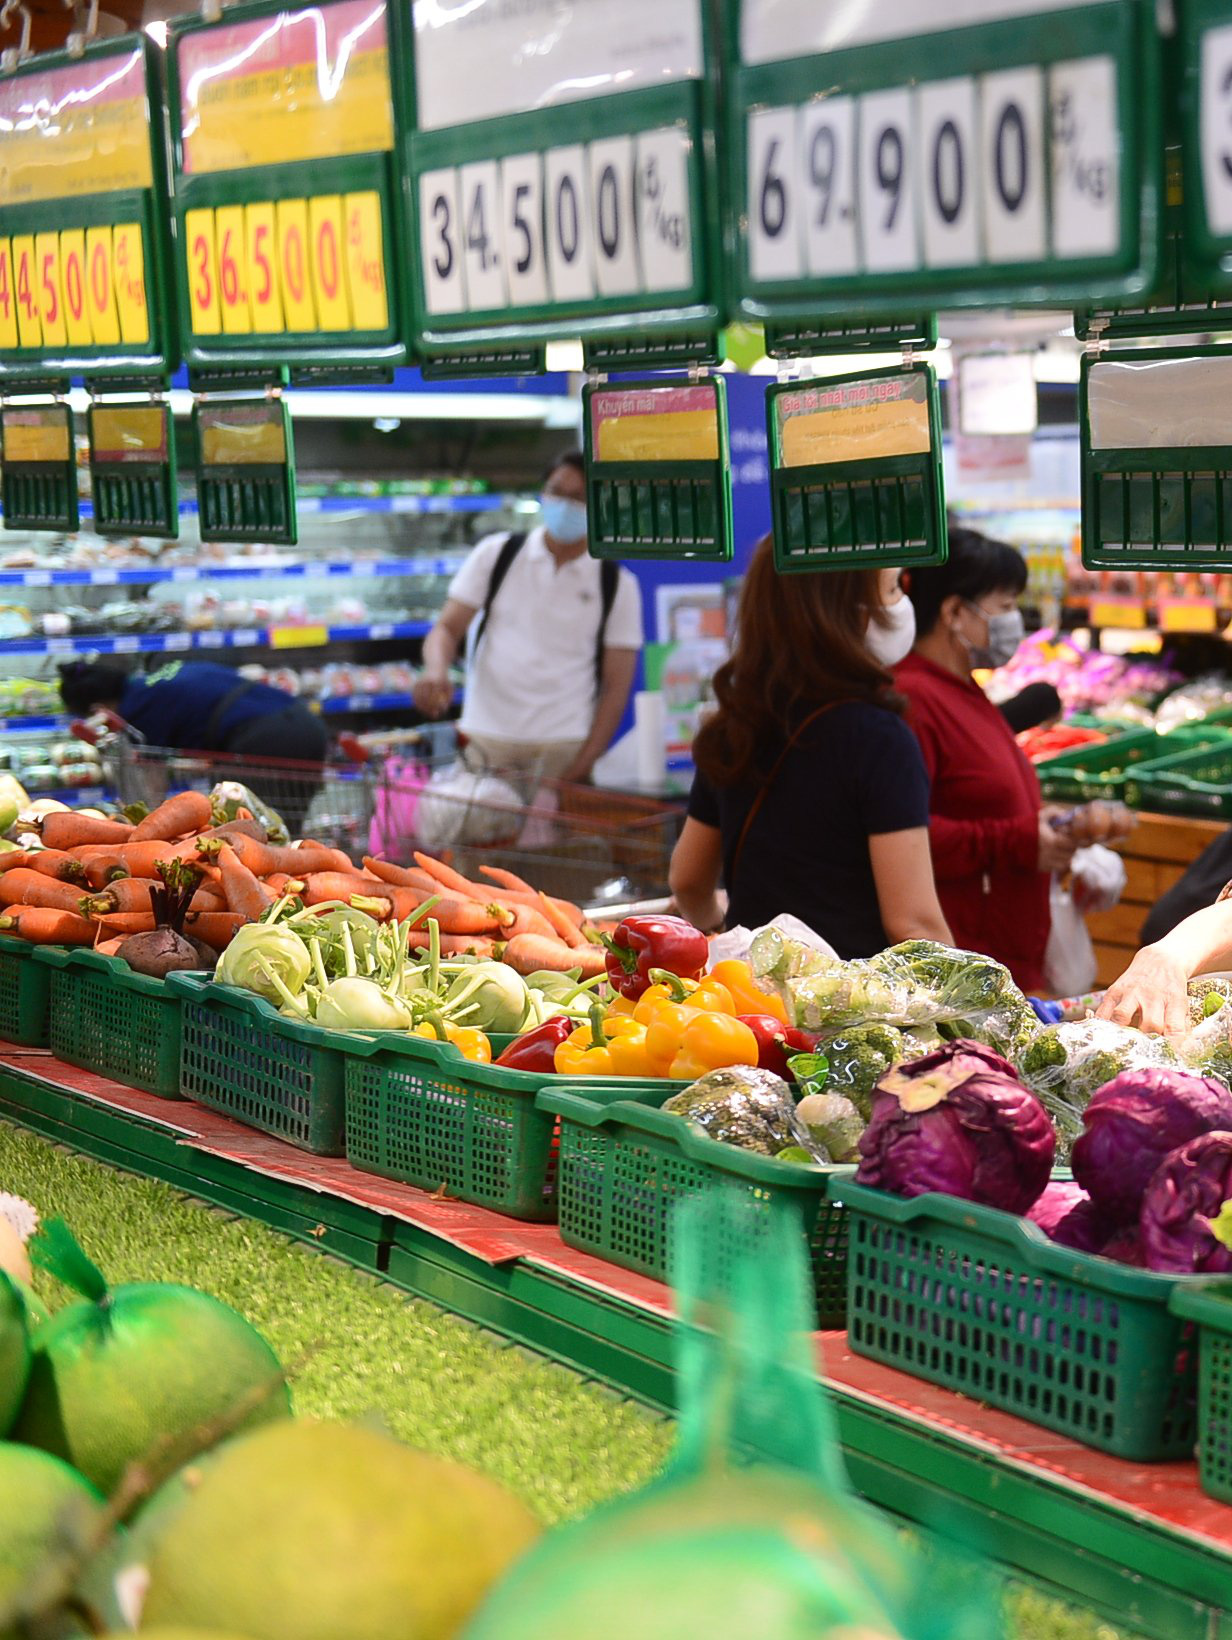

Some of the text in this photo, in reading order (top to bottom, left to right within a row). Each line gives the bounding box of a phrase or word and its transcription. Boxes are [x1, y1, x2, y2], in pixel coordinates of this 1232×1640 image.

[433, 164, 619, 279] 34.500
[761, 101, 1028, 238] 69.900
[193, 219, 339, 311] 36.500
